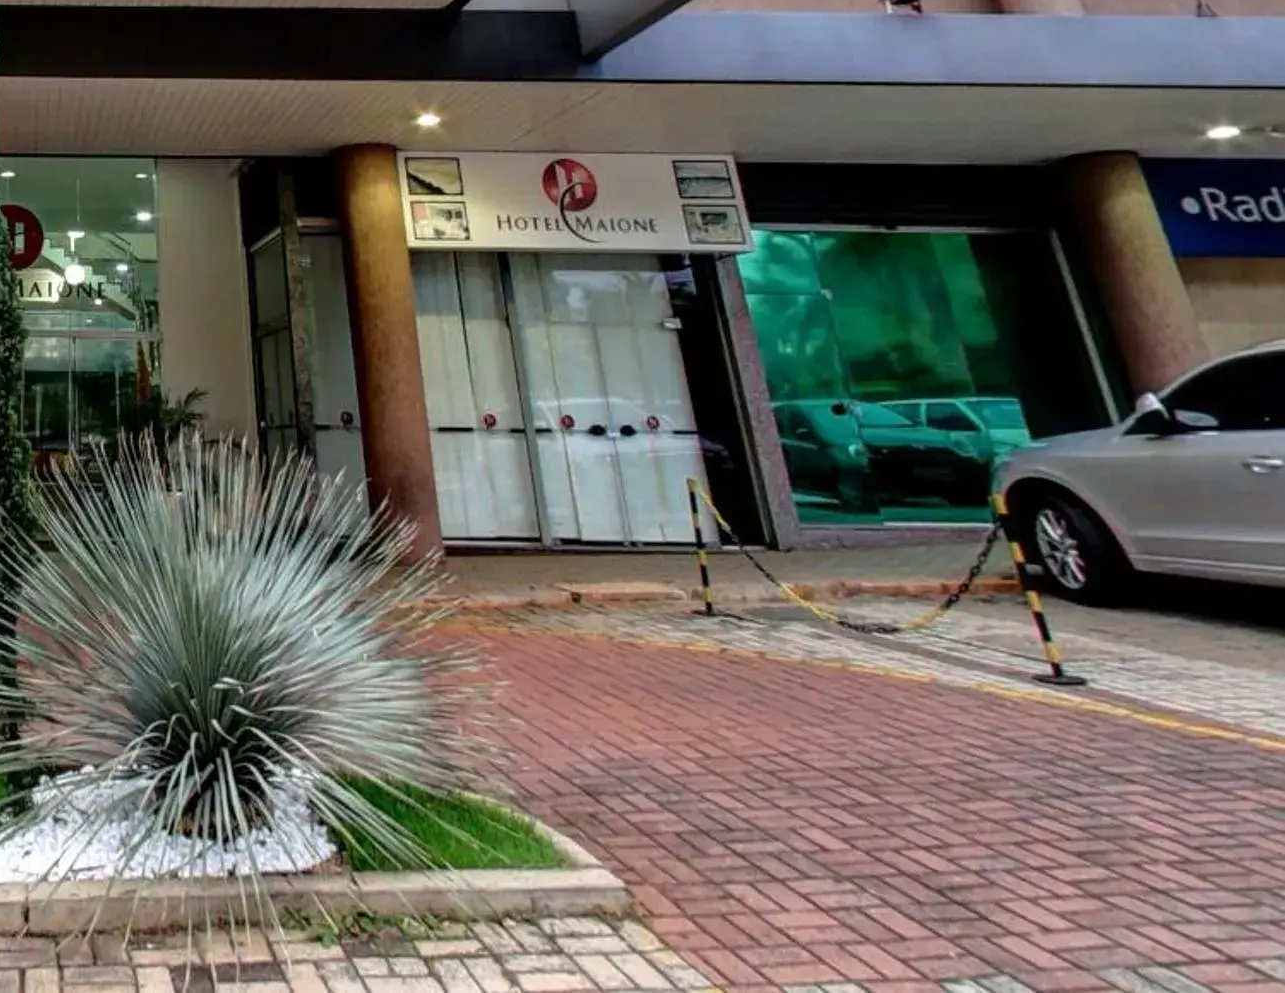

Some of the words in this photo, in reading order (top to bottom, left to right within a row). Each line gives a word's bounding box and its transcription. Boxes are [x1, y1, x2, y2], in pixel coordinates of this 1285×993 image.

[1199, 187, 1285, 222] Rad
[496, 214, 562, 232] HOTEL
[574, 215, 658, 233] MAIONE
